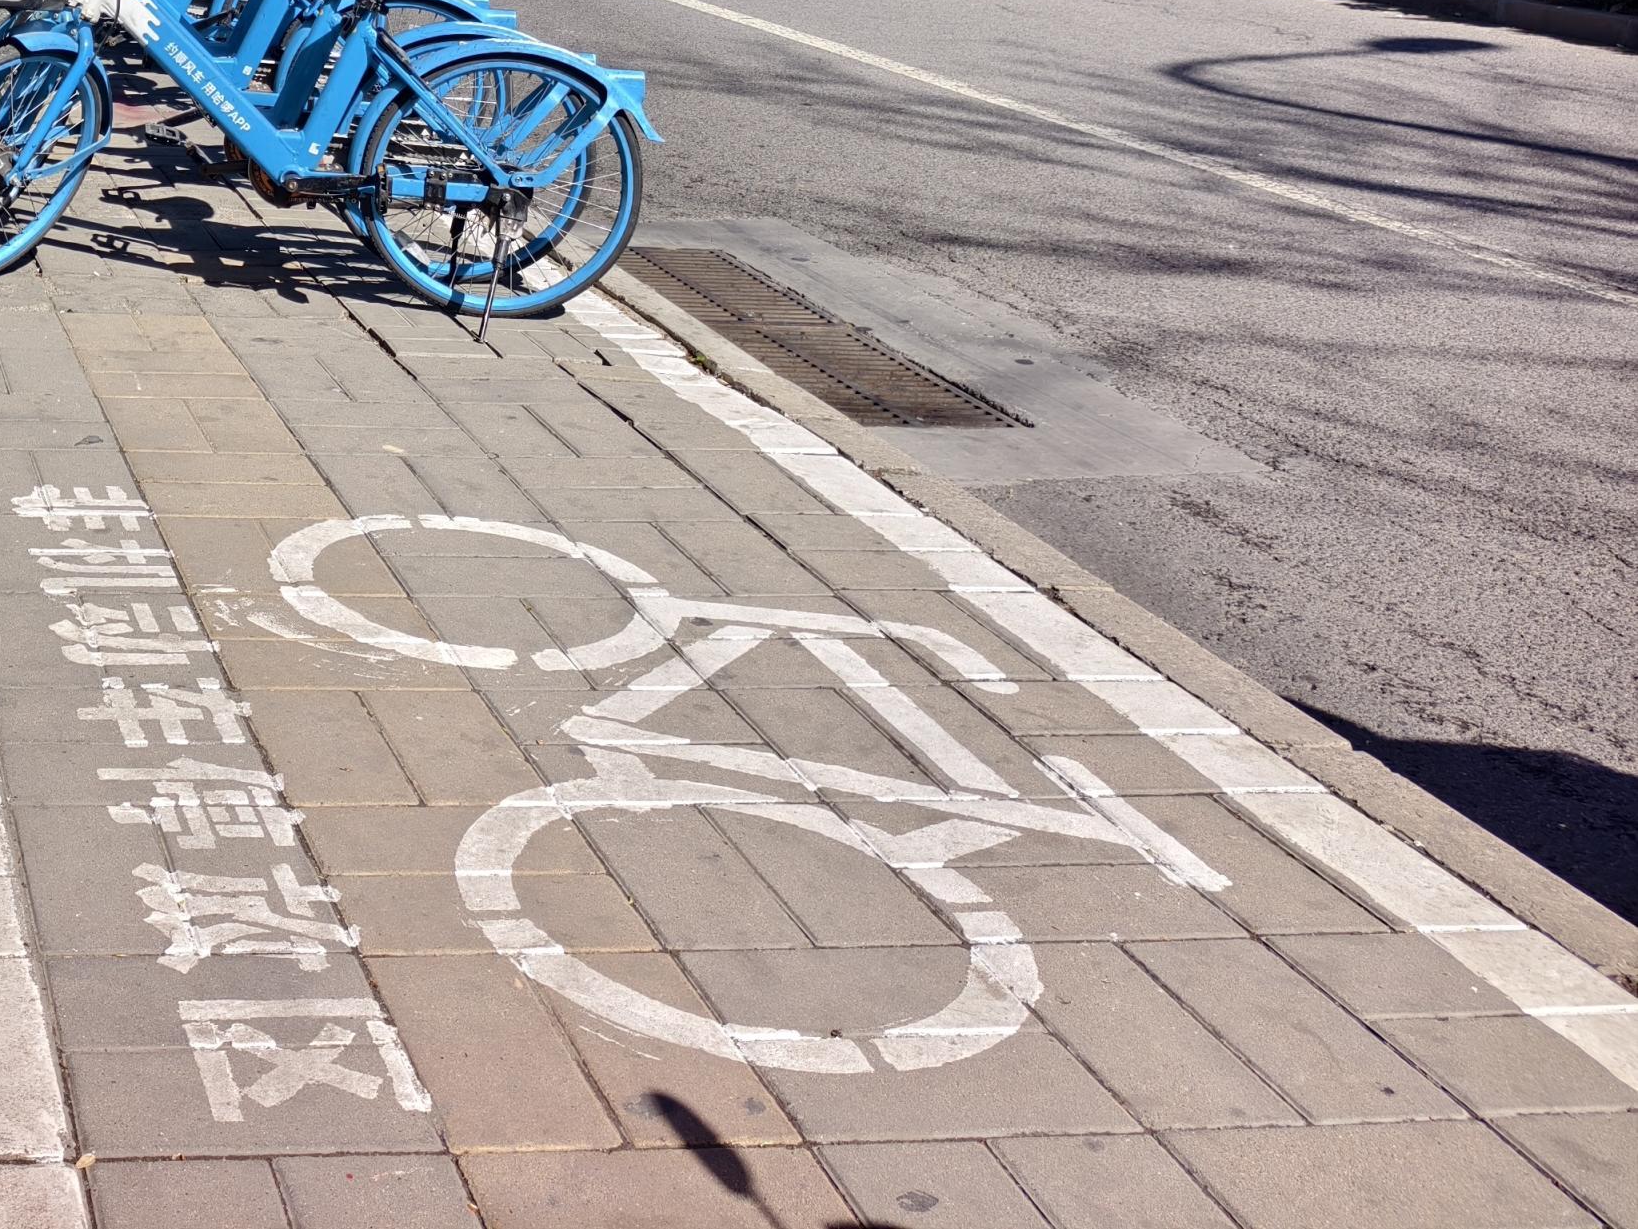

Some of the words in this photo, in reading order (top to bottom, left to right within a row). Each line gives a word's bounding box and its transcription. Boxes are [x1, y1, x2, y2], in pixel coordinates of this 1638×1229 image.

[164, 42, 206, 84] 约顺风车
[10, 484, 432, 1123] 非机动车停放区
